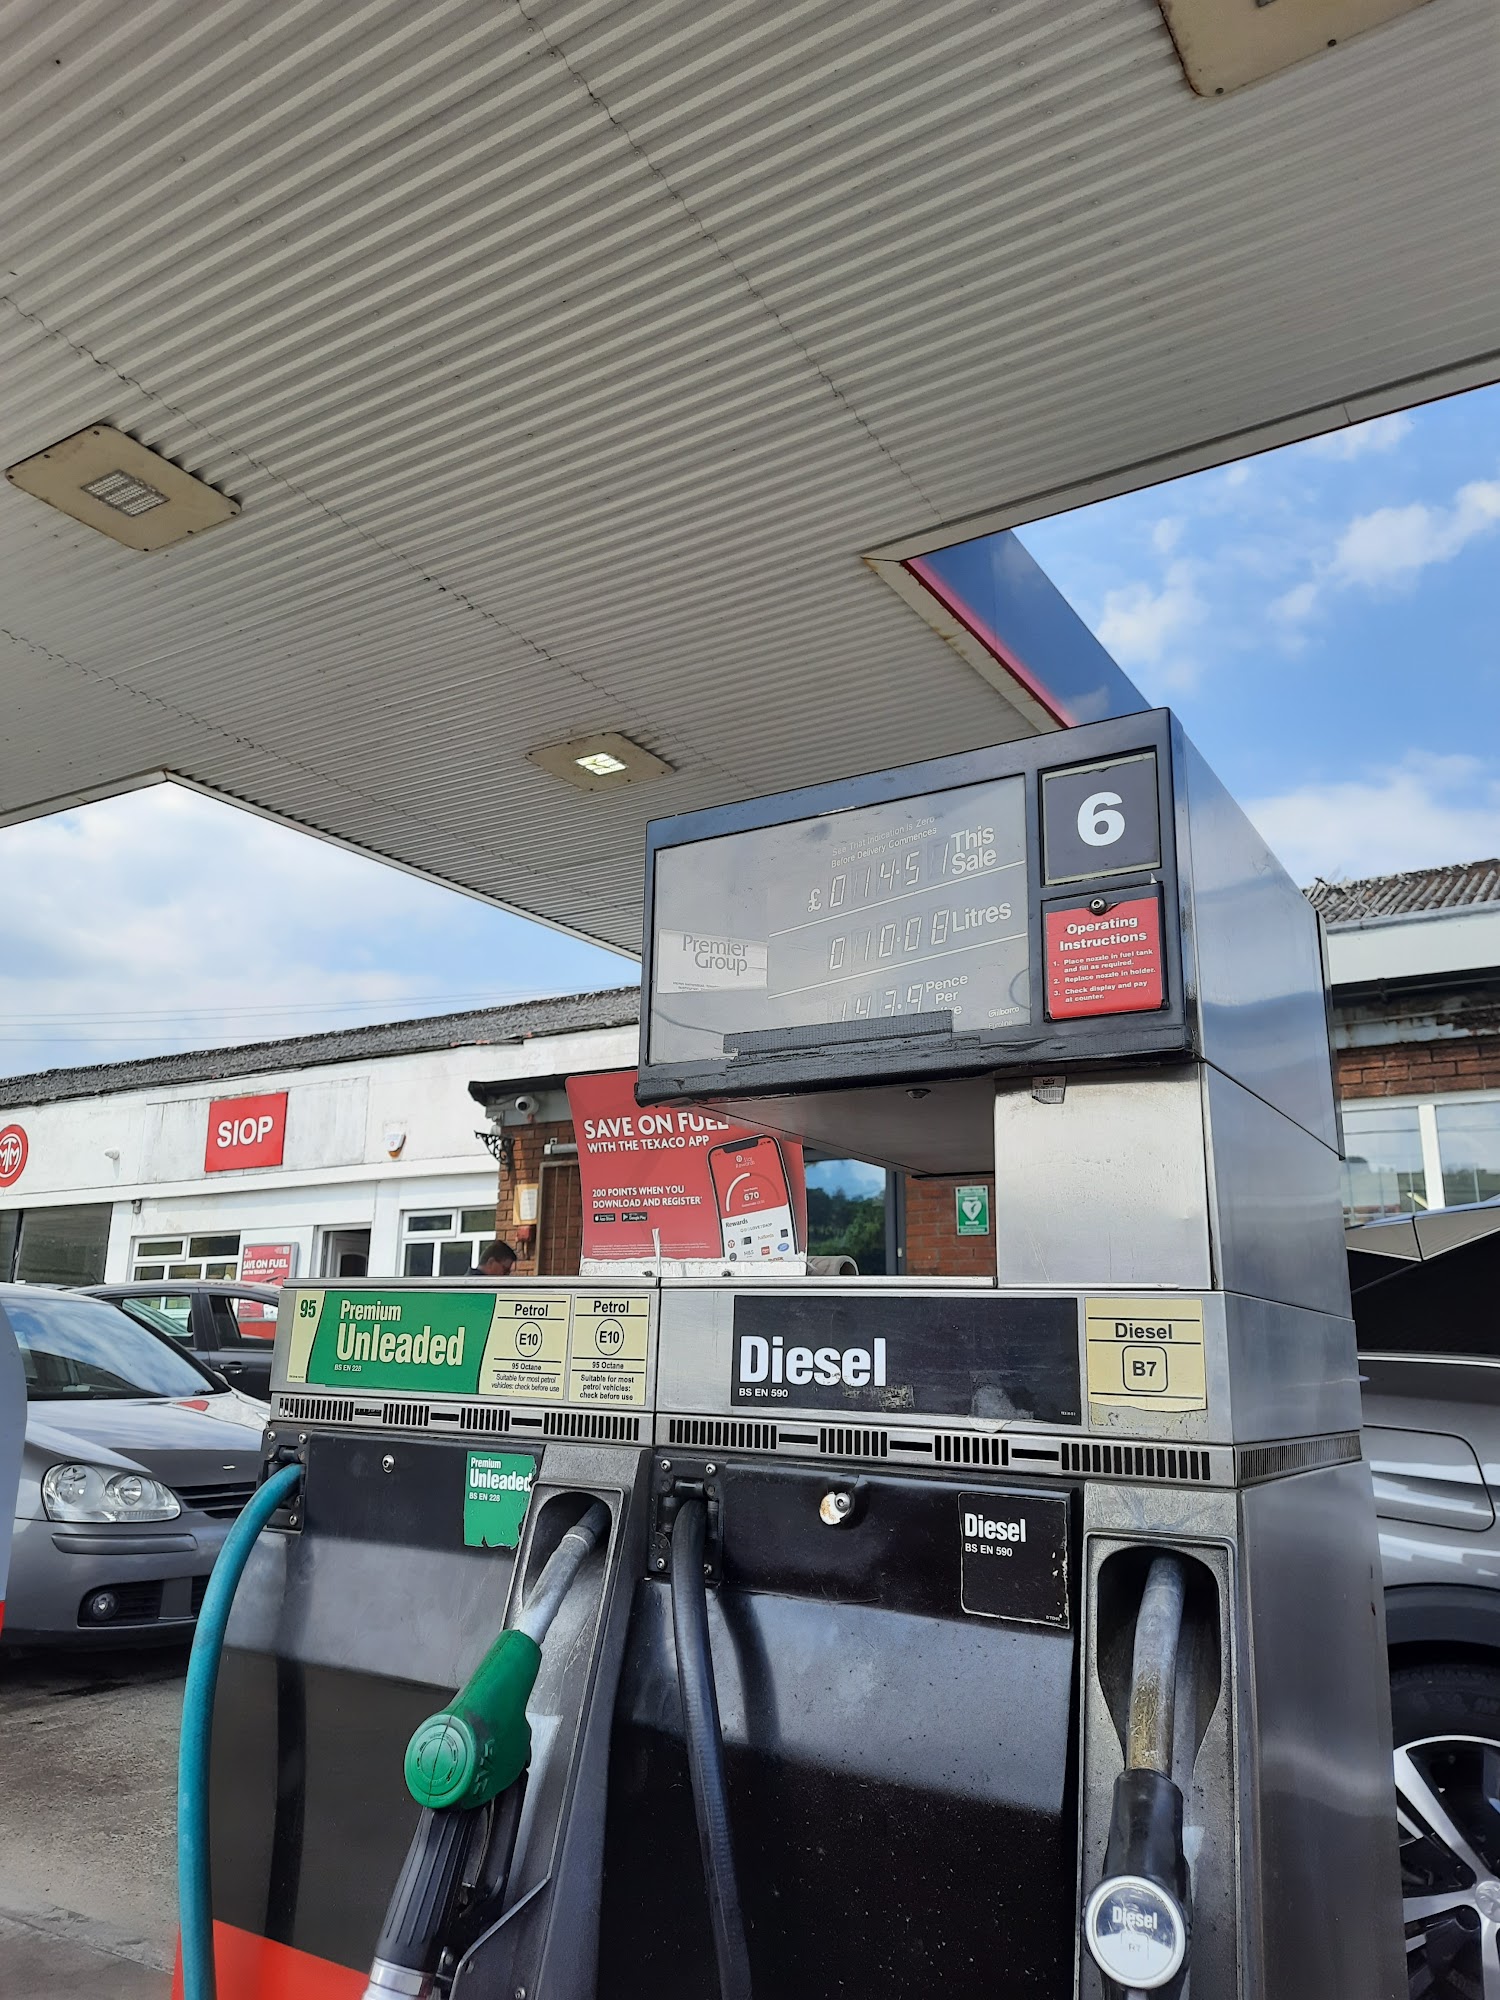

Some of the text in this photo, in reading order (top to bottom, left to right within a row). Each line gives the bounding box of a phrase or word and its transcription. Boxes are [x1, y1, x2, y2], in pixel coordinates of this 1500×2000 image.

[1077, 791, 1125, 847] 6
[832, 845, 847, 857] See
[849, 840, 866, 852] That
[867, 827, 905, 845] Indication
[916, 816, 935, 828] Zero
[951, 825, 995, 852] This
[831, 827, 937, 868] Before Delivery Commences
[951, 848, 997, 875] Sale
[952, 902, 1012, 933] Litres
[1066, 917, 1138, 935] Operating
[682, 934, 749, 957] Premier
[1060, 932, 1147, 951] Instructions
[695, 951, 748, 976] Group
[1086, 954, 1109, 962] nozzle
[1101, 960, 1134, 971] required.
[926, 975, 968, 992] Pence
[1065, 975, 1093, 984] Replace
[1096, 971, 1119, 979] nozzle
[1065, 986, 1088, 995] Check
[1090, 983, 1116, 993] display
[1133, 981, 1147, 990] pay
[935, 991, 958, 1004] Per
[1074, 993, 1104, 1002] counter.
[583, 1117, 634, 1139] SAVE
[638, 1113, 673, 1135] ON
[587, 1135, 710, 1153] WITH THE TEXACO APP
[592, 1185, 685, 1198] 200 POINTS WHEN YOU
[744, 1191, 759, 1201] 670
[593, 1198, 641, 1209] DOWNLOAD
[643, 1197, 660, 1207] AND
[725, 1218, 749, 1228] Rewards
[256, 1259, 267, 1269] ON
[269, 1258, 288, 1268] FUEL
[300, 1299, 316, 1318] 95
[340, 1300, 402, 1322] Premium
[514, 1304, 549, 1317] Petrol
[593, 1300, 630, 1314] Petrol
[600, 1331, 620, 1344] E10
[1115, 1322, 1173, 1340] Diesel
[336, 1323, 465, 1366] Unleaded
[519, 1333, 538, 1346] E10
[334, 1363, 342, 1371] BS
[520, 1363, 542, 1371] Octane
[592, 1361, 624, 1370] 95 Octane
[739, 1335, 887, 1387] Diesel
[1132, 1360, 1157, 1377] B7
[496, 1373, 518, 1382] Suitable
[518, 1374, 526, 1382] for
[539, 1376, 556, 1385] petrol
[580, 1374, 634, 1384] Suitable for most
[514, 1383, 531, 1391] check
[531, 1383, 548, 1392] before
[582, 1383, 601, 1392] petrol
[739, 1388, 789, 1398] BS EN 590
[580, 1390, 633, 1401] check before use
[470, 1457, 502, 1469] Premium
[469, 1468, 533, 1492] Unleaded
[469, 1492, 501, 1502] BS EN 228
[964, 1512, 1027, 1543] Diesel
[965, 1544, 1013, 1557] BS EN 590
[1112, 1906, 1158, 1930] Diesel
